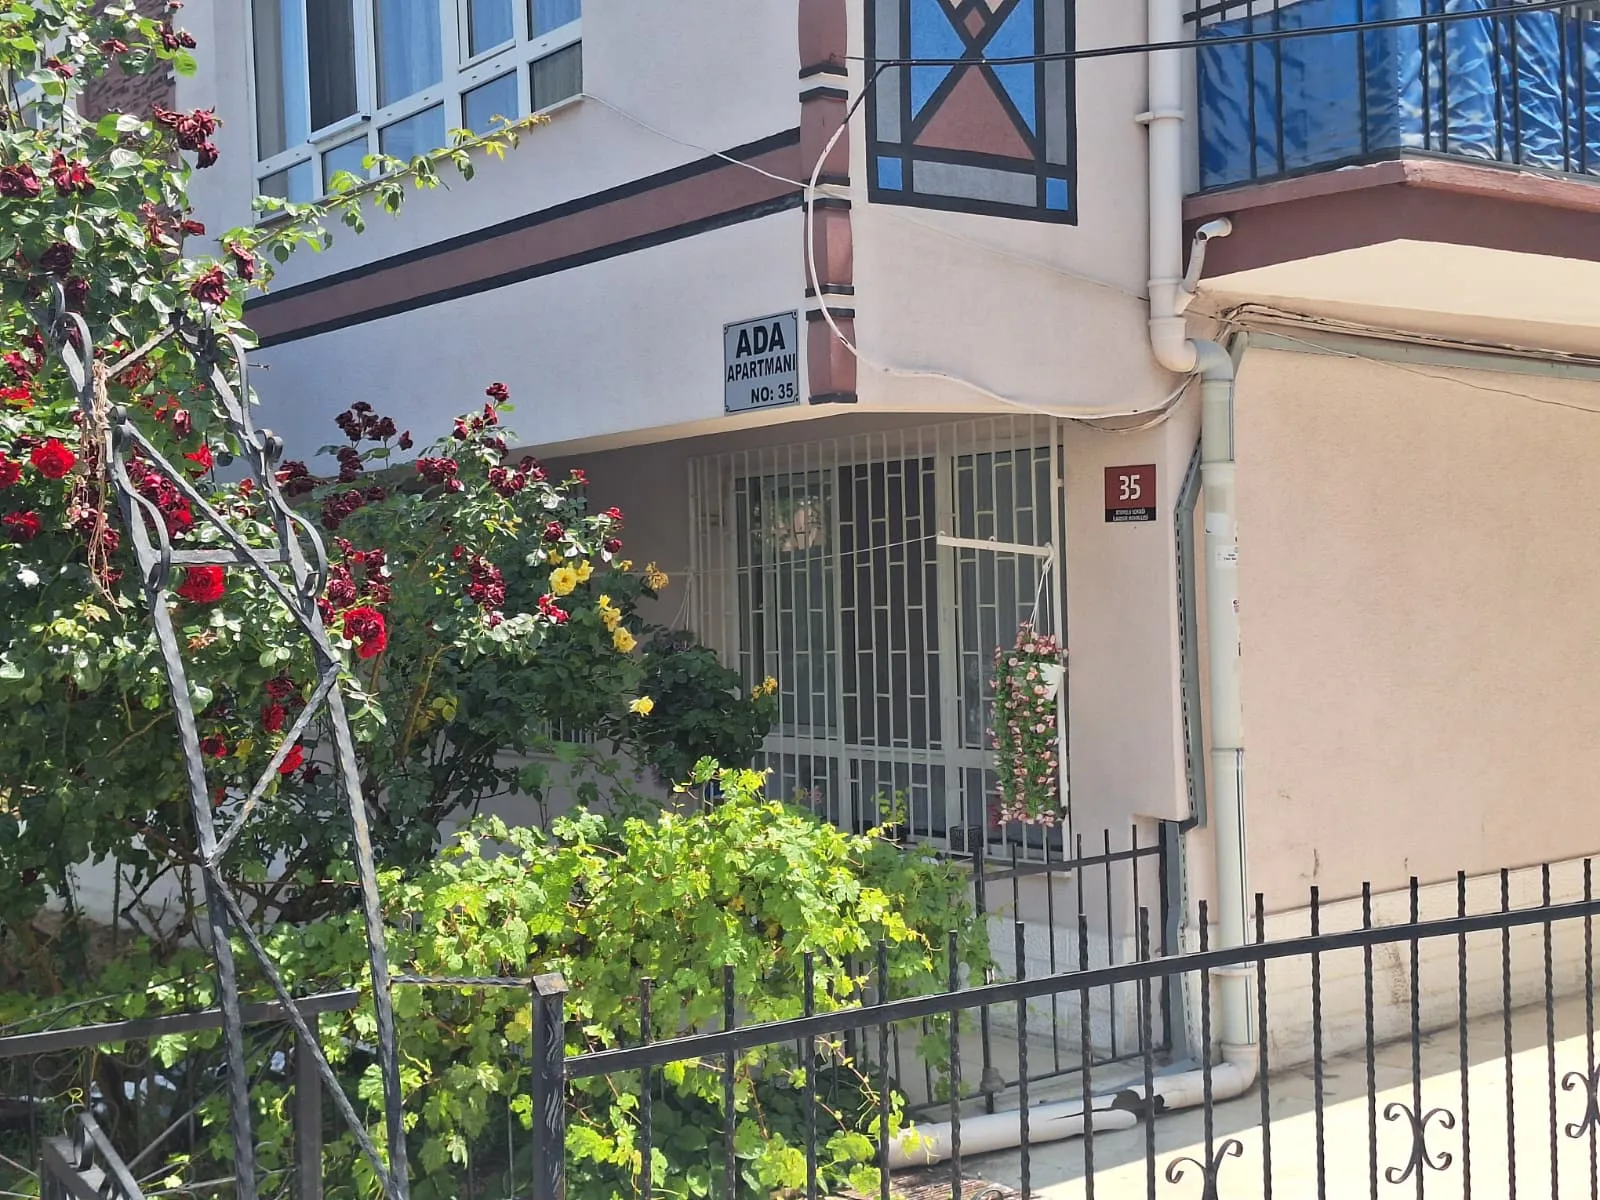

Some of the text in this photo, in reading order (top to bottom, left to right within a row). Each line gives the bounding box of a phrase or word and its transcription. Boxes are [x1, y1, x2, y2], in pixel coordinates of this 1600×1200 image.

[736, 322, 785, 358] ADA
[727, 353, 796, 382] APARTMANI
[751, 382, 794, 403] NO: 35
[1119, 474, 1141, 501] 35
